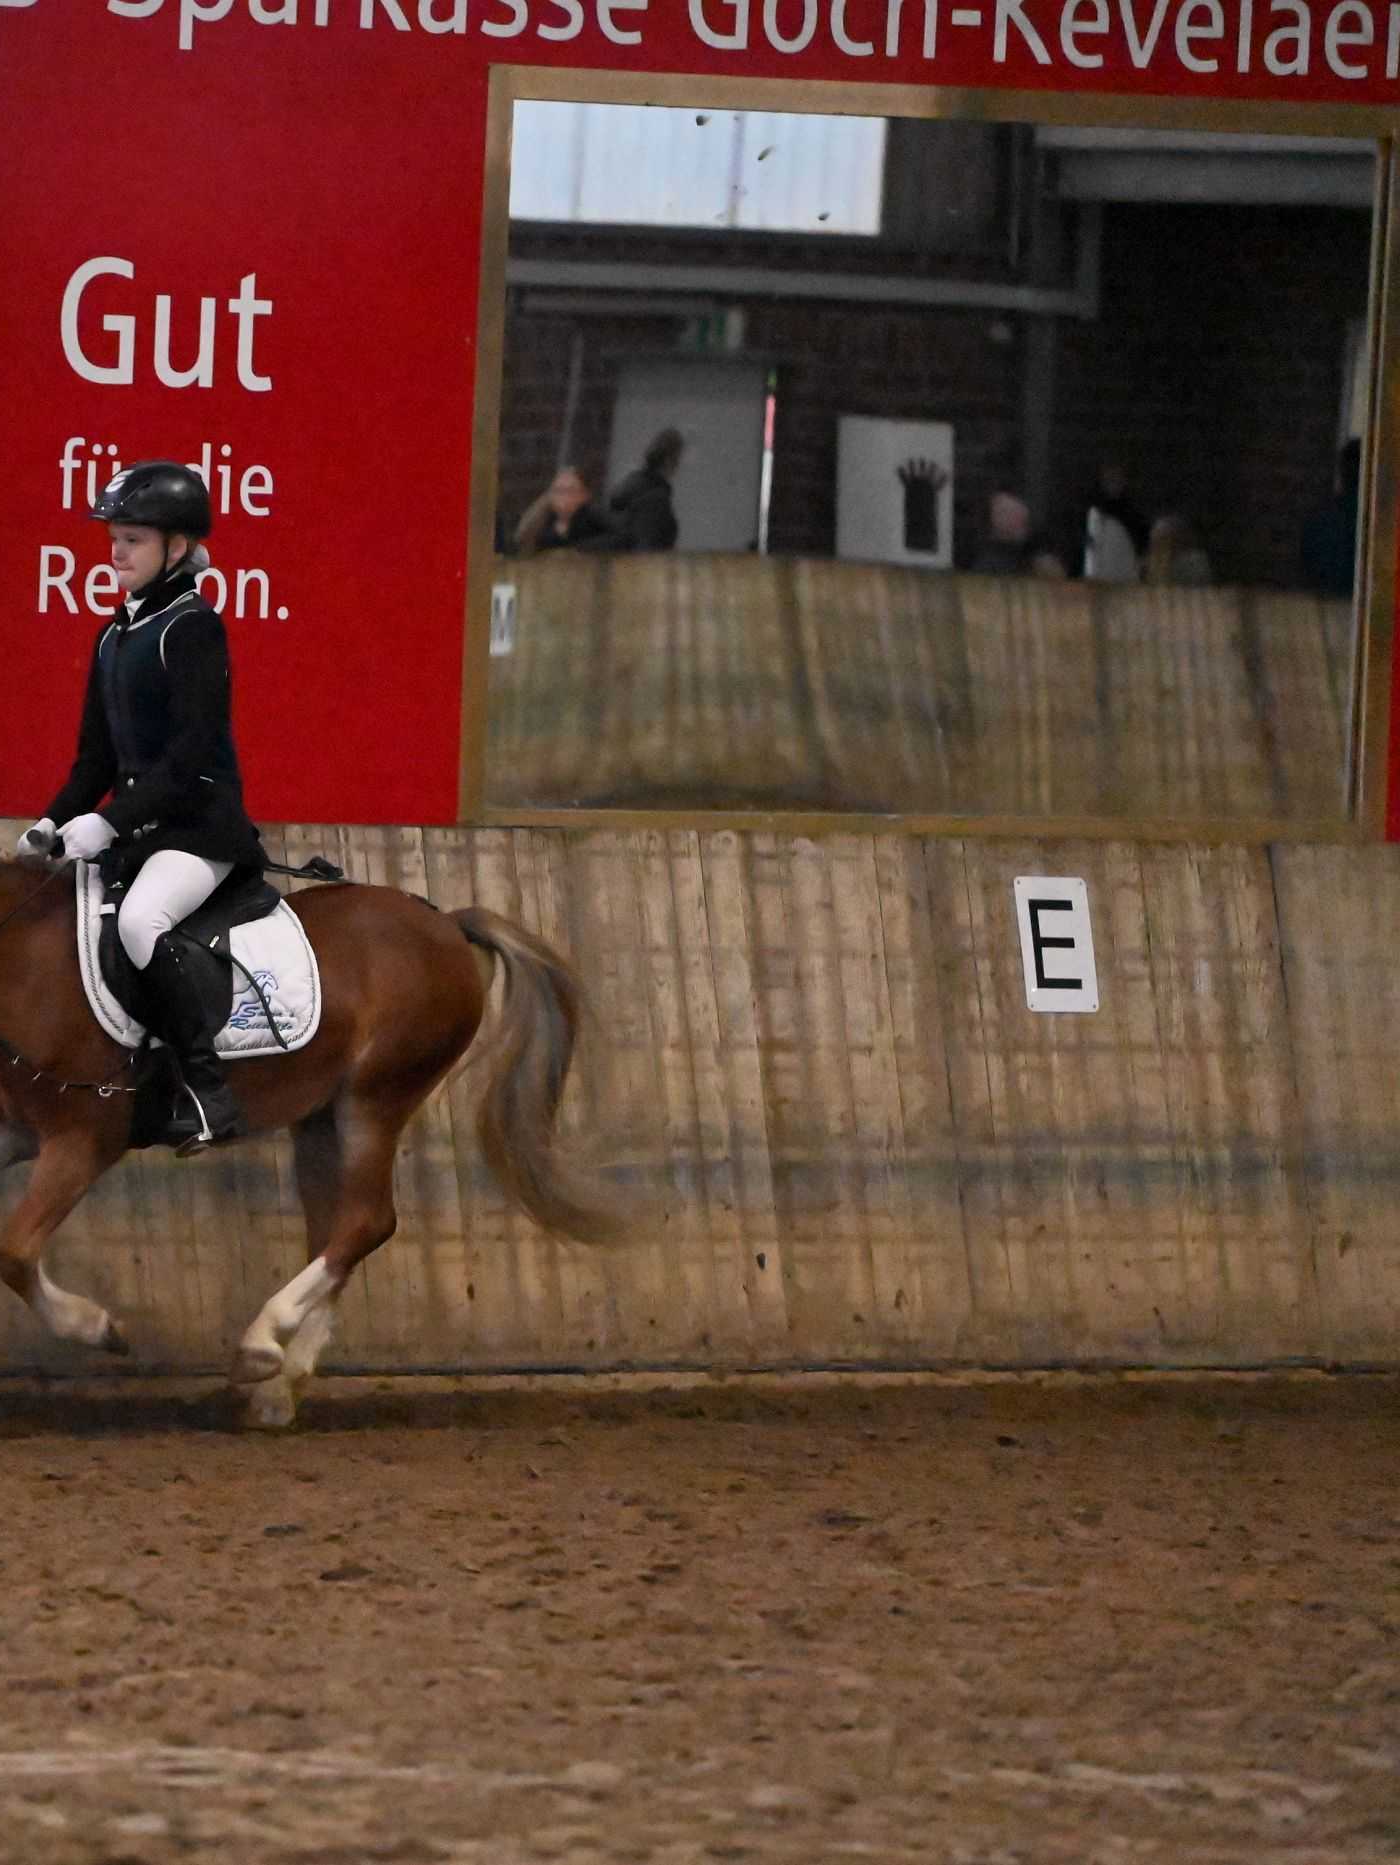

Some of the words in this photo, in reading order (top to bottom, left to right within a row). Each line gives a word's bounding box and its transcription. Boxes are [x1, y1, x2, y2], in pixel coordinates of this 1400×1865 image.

[60, 256, 274, 391] Gut
[59, 437, 130, 511] fü
[38, 545, 290, 620] Reon.
[1028, 899, 1082, 989] E
